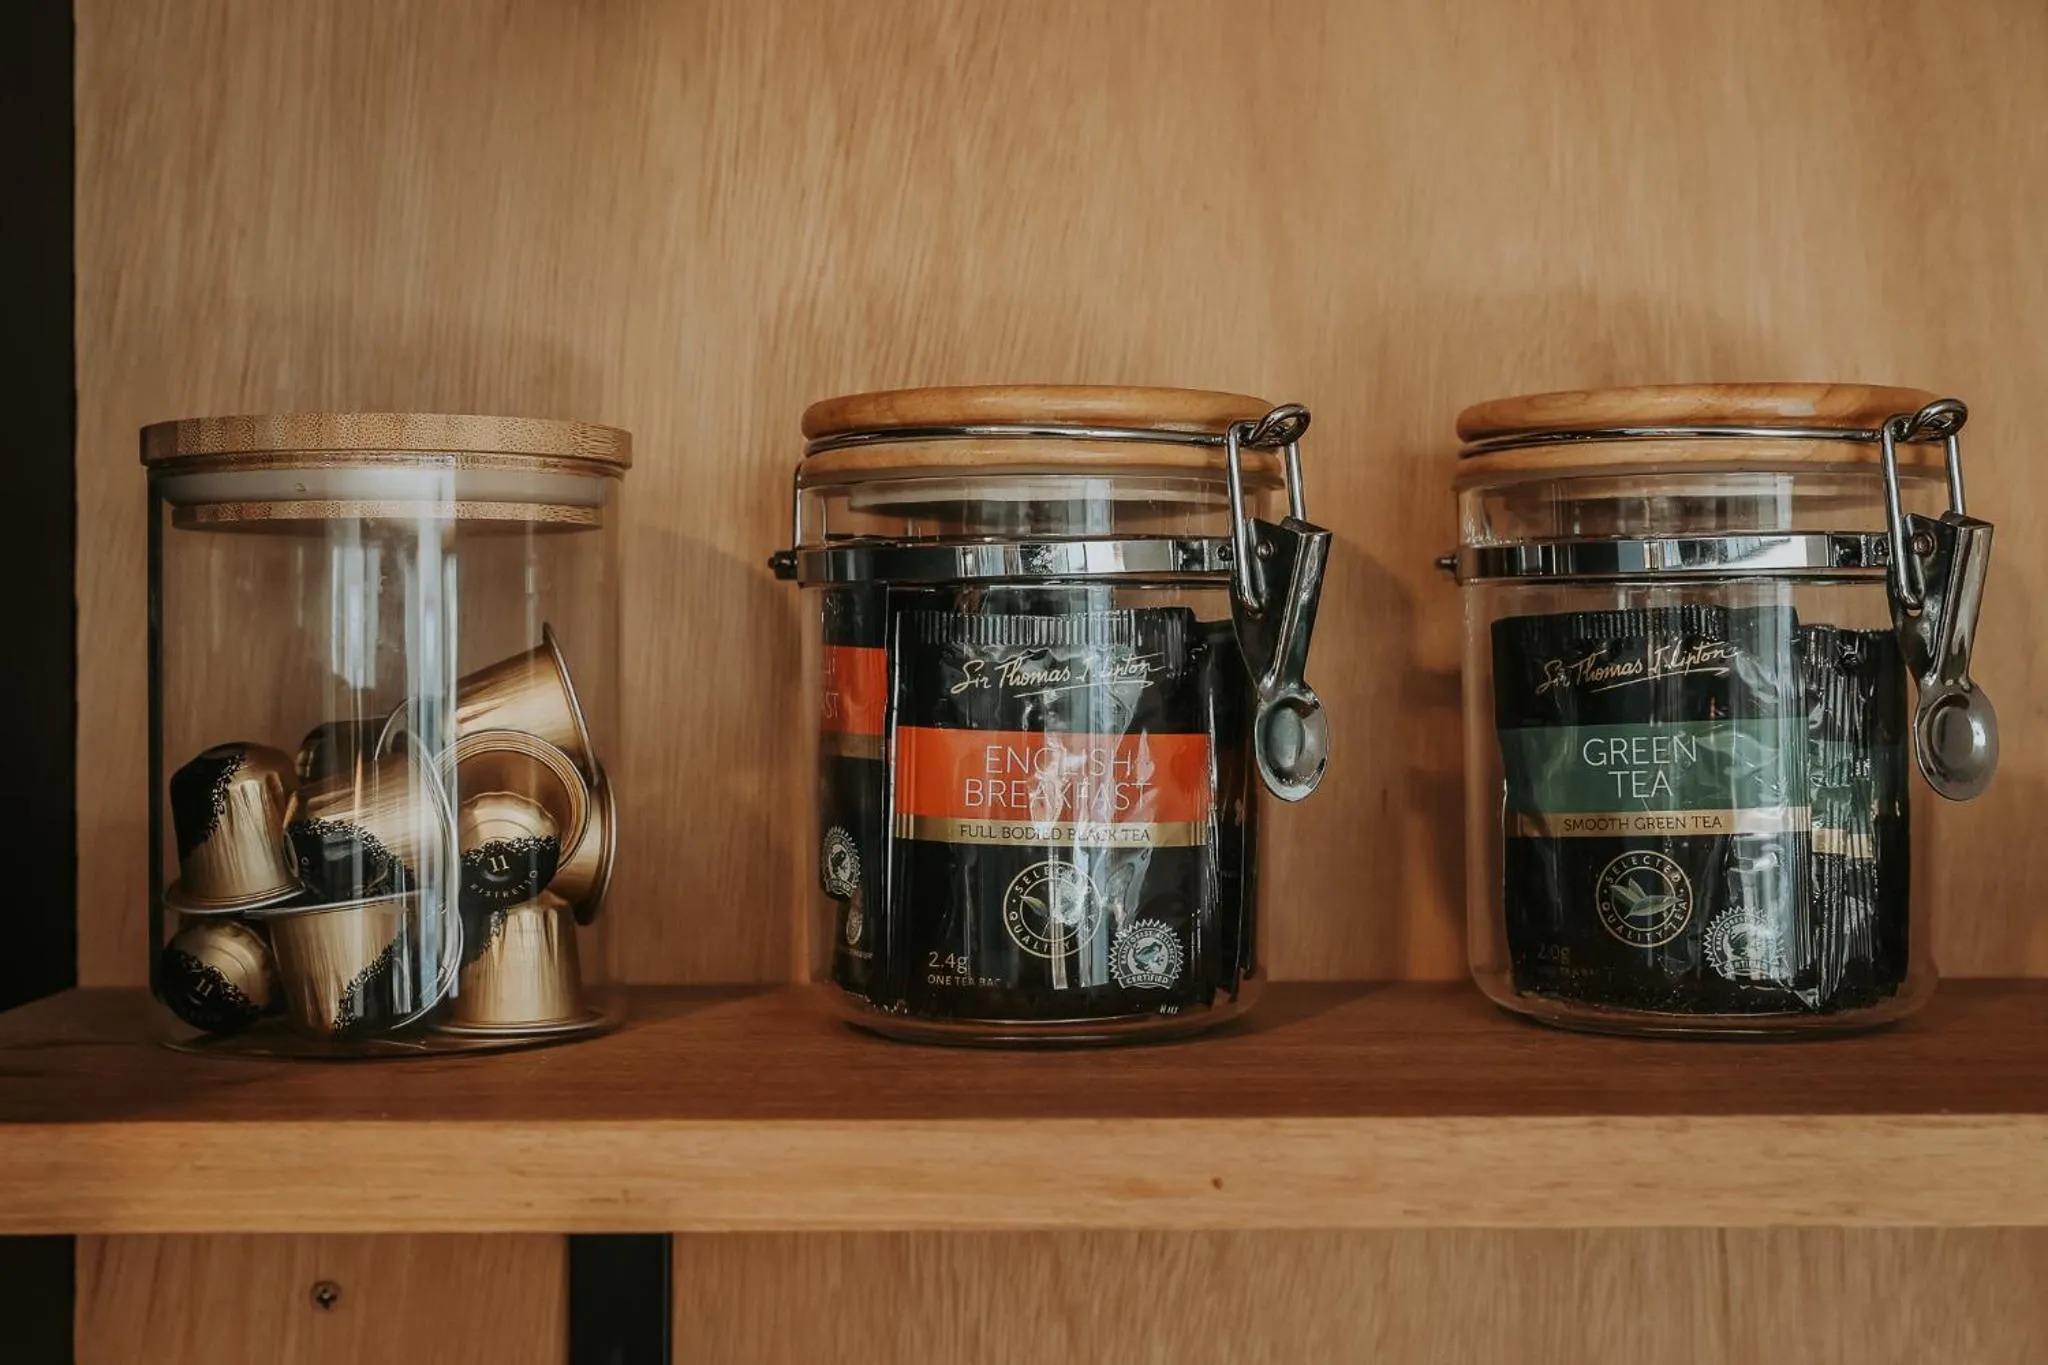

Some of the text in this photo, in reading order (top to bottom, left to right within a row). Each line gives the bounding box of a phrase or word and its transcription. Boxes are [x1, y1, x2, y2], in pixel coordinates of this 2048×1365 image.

[951, 659, 992, 694] Sir
[994, 654, 1071, 689] Thomas
[1536, 659, 1570, 695] Sir
[1568, 650, 1644, 686] Thomas
[985, 745, 1131, 778] ENGLISH
[1583, 735, 1697, 767] GREEN
[965, 778, 1152, 809] BREAKFAST
[1607, 769, 1674, 799] TEA
[960, 824, 997, 839] FULL
[1121, 828, 1151, 842] TEA
[1563, 815, 1723, 832] SMOOTH GREEN TEA
[489, 854, 511, 873] 11
[1605, 855, 1681, 884] SELECTED
[1009, 910, 1071, 953] QUALIY
[1601, 900, 1688, 942] QUALITY TEA
[928, 951, 968, 974] 2.4g
[927, 974, 952, 986] ONE
[954, 976, 976, 987] TEA
